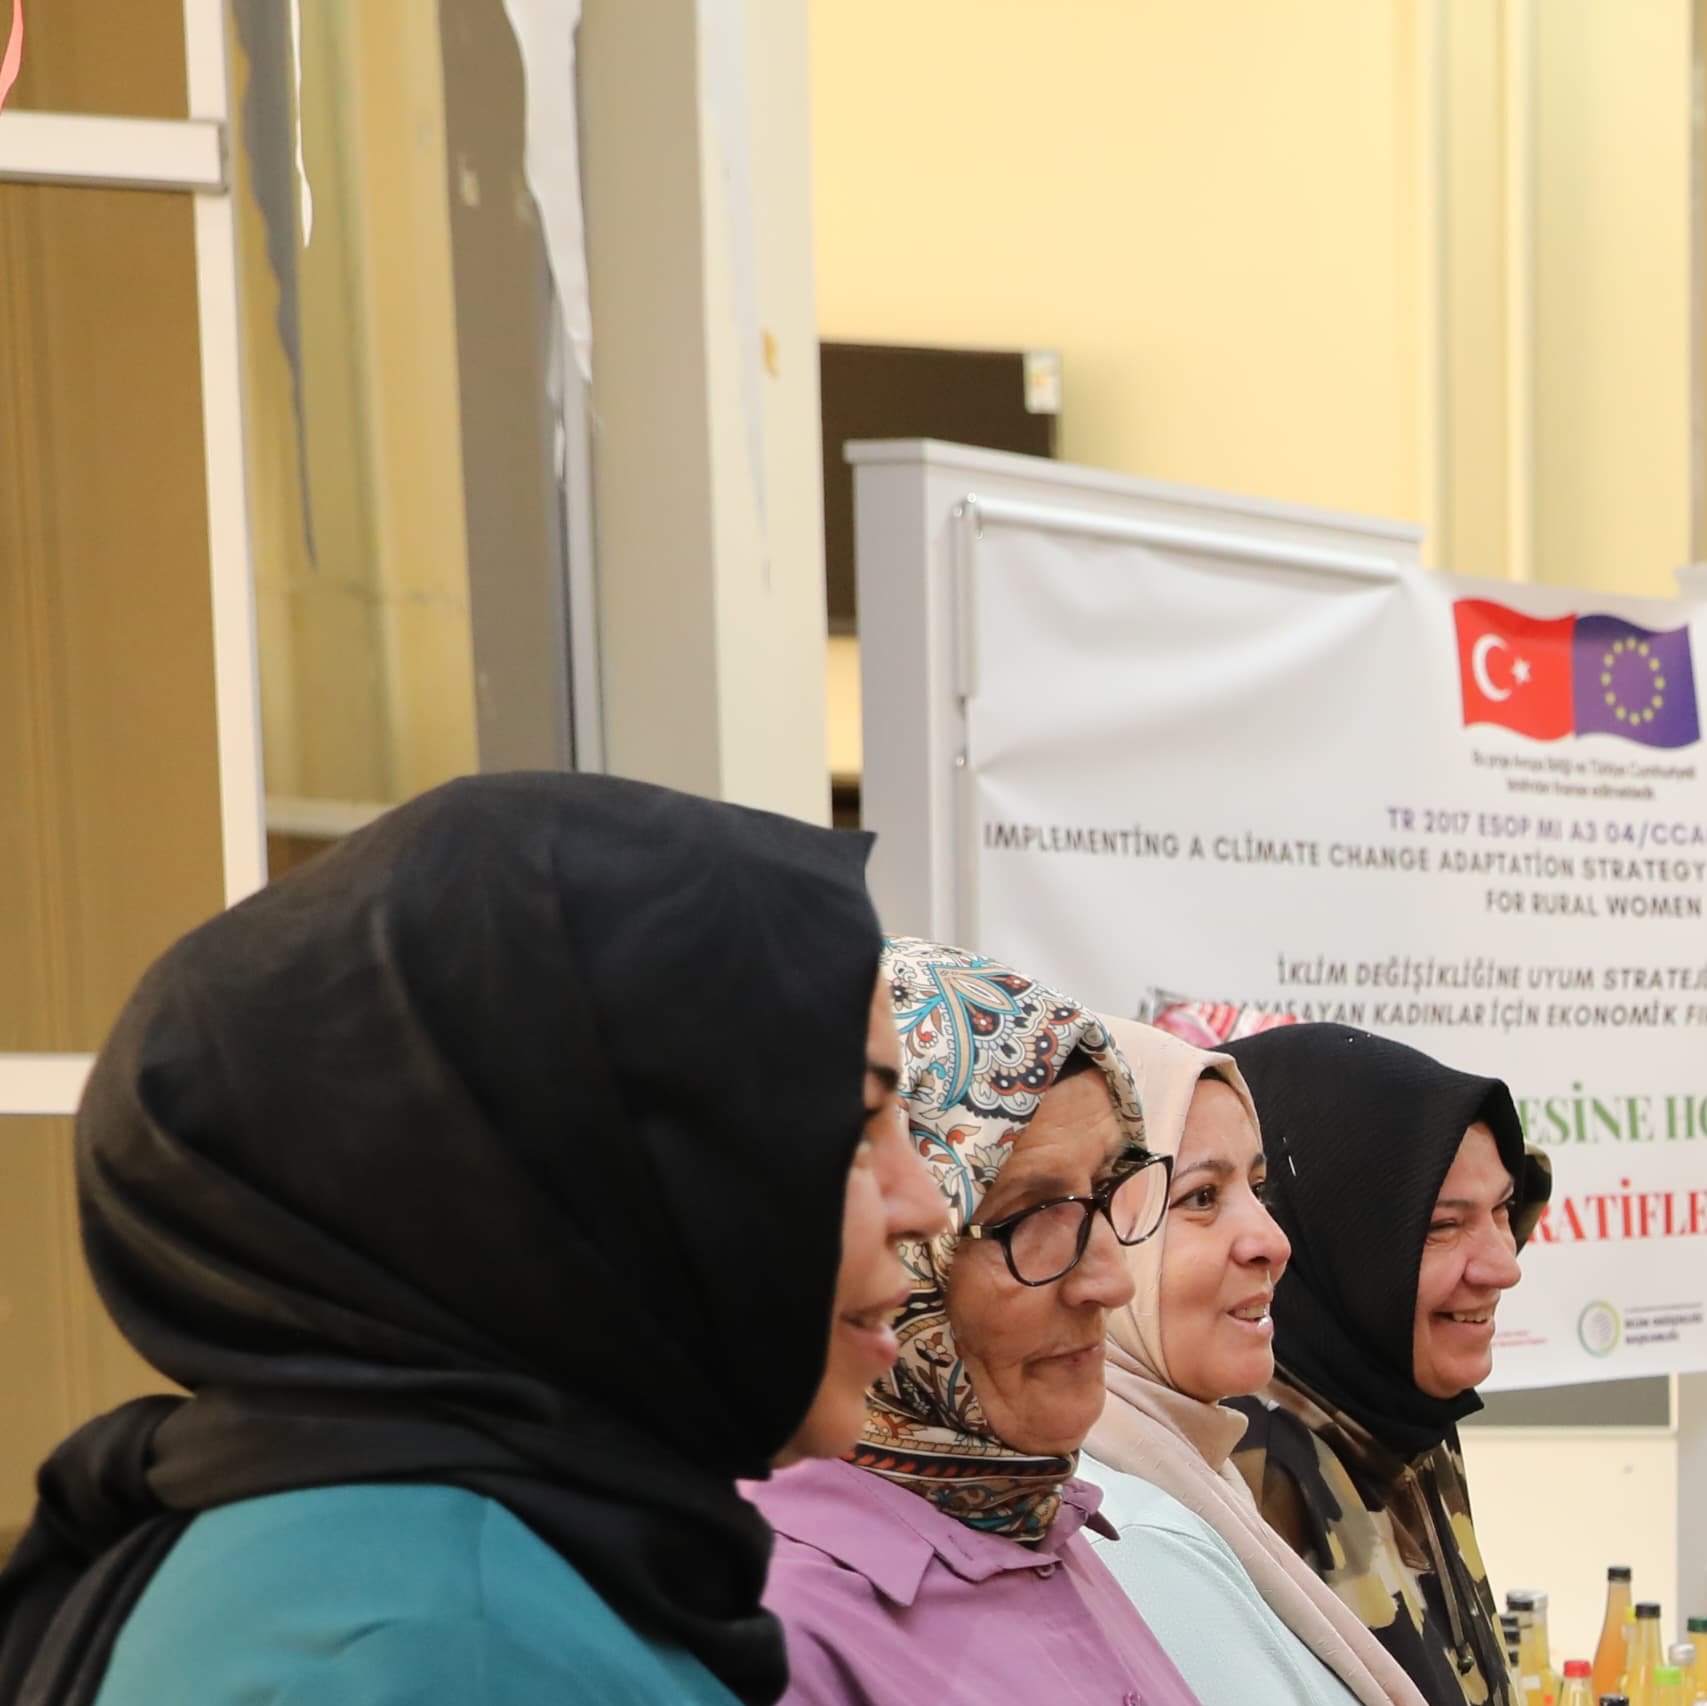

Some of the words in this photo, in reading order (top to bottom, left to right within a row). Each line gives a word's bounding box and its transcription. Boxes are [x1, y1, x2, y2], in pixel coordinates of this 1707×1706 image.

[1387, 807, 1414, 831] TR
[1423, 809, 1471, 834] 2017
[1478, 813, 1531, 838] ESOP
[1569, 821, 1598, 843] A3
[1188, 835, 1206, 861] A
[1329, 843, 1429, 872] CHANGE
[1583, 858, 1705, 883] STRATEGY
[1485, 889, 1524, 915] FOR
[1532, 890, 1599, 917] RURAL
[1606, 893, 1703, 918] WOMEN
[1277, 952, 1348, 986] İKLİM
[1527, 968, 1595, 991] UYUM
[1373, 1001, 1485, 1026] KADINLAR
[1491, 998, 1539, 1033] İÇİN
[1546, 1000, 1676, 1027] EKONOMİK
